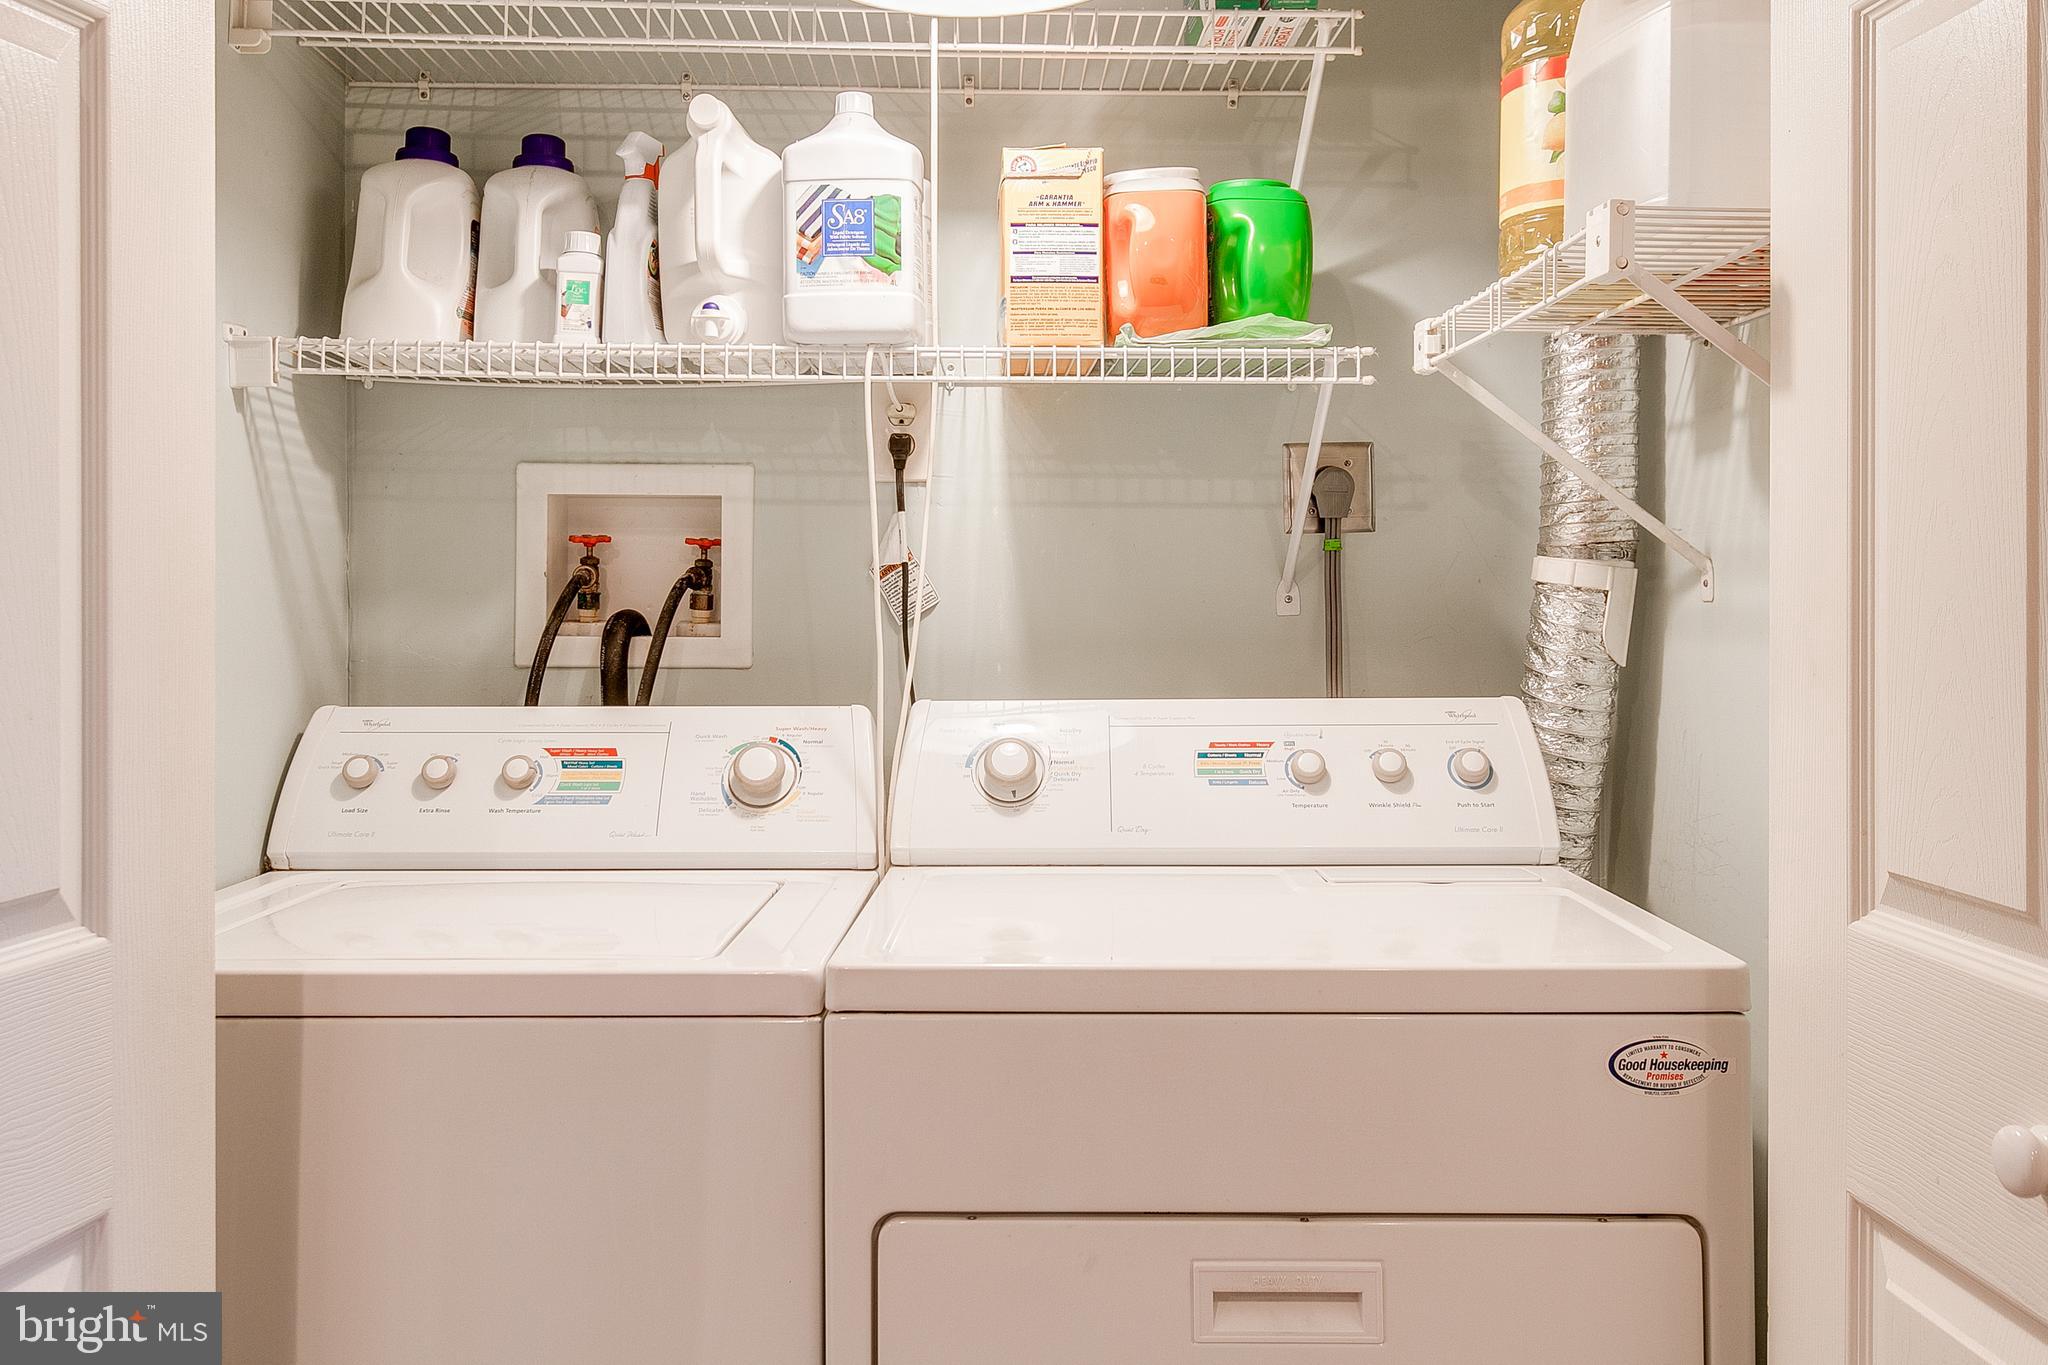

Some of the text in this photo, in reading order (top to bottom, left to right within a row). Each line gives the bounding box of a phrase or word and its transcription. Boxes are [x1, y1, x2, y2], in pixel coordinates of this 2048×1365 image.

[505, 807, 542, 815] Temperature
[1626, 1047, 1643, 1058] LIMITED
[1644, 1044, 1667, 1052] WARRANTY
[1675, 1045, 1702, 1057] CONSUMERS
[1618, 1058, 1729, 1074] Good Housekeeping
[1622, 1073, 1652, 1087] REPLACEMENT
[1683, 1074, 1706, 1086] DEFECTIVE
[1646, 1072, 1684, 1081] Promises
